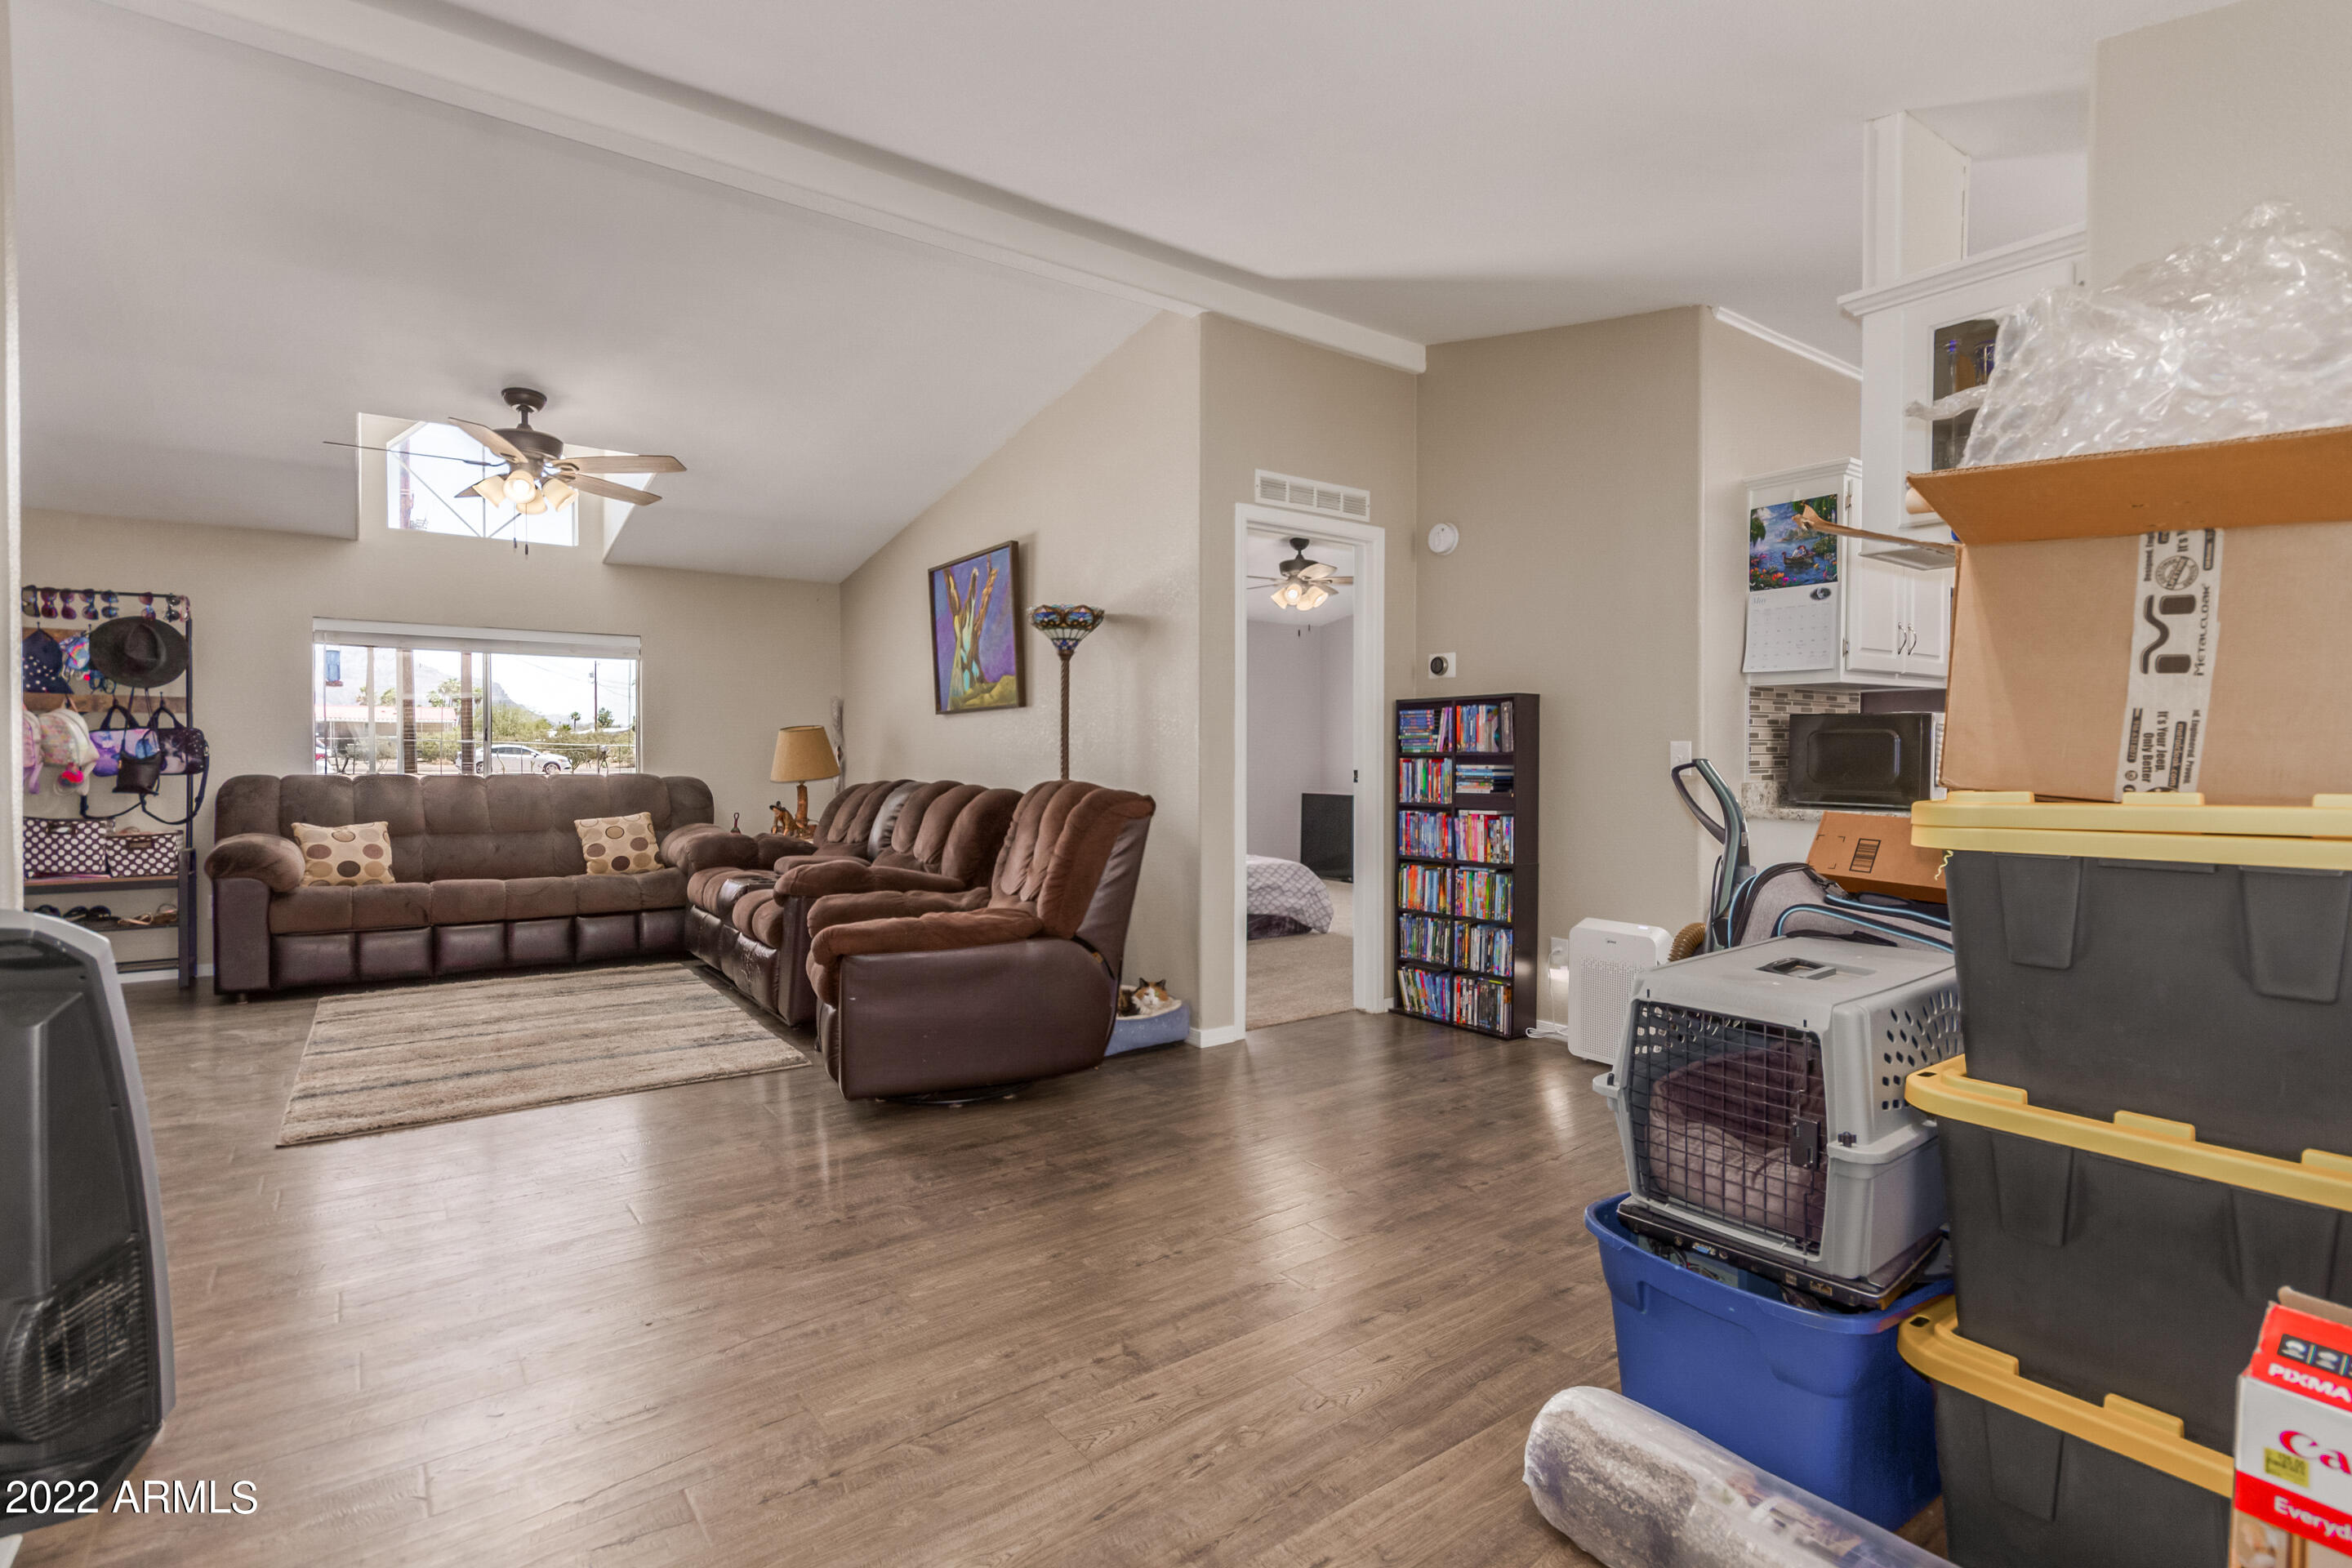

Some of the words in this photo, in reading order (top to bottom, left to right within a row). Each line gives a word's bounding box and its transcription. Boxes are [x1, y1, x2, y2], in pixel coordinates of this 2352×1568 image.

[2157, 710, 2169, 725] It's
[2141, 732, 2155, 752] Only
[2156, 727, 2168, 747] Your
[2141, 755, 2154, 782] Better
[2268, 1362, 2351, 1403] PIXMA
[2274, 1494, 2352, 1542] Everyd
